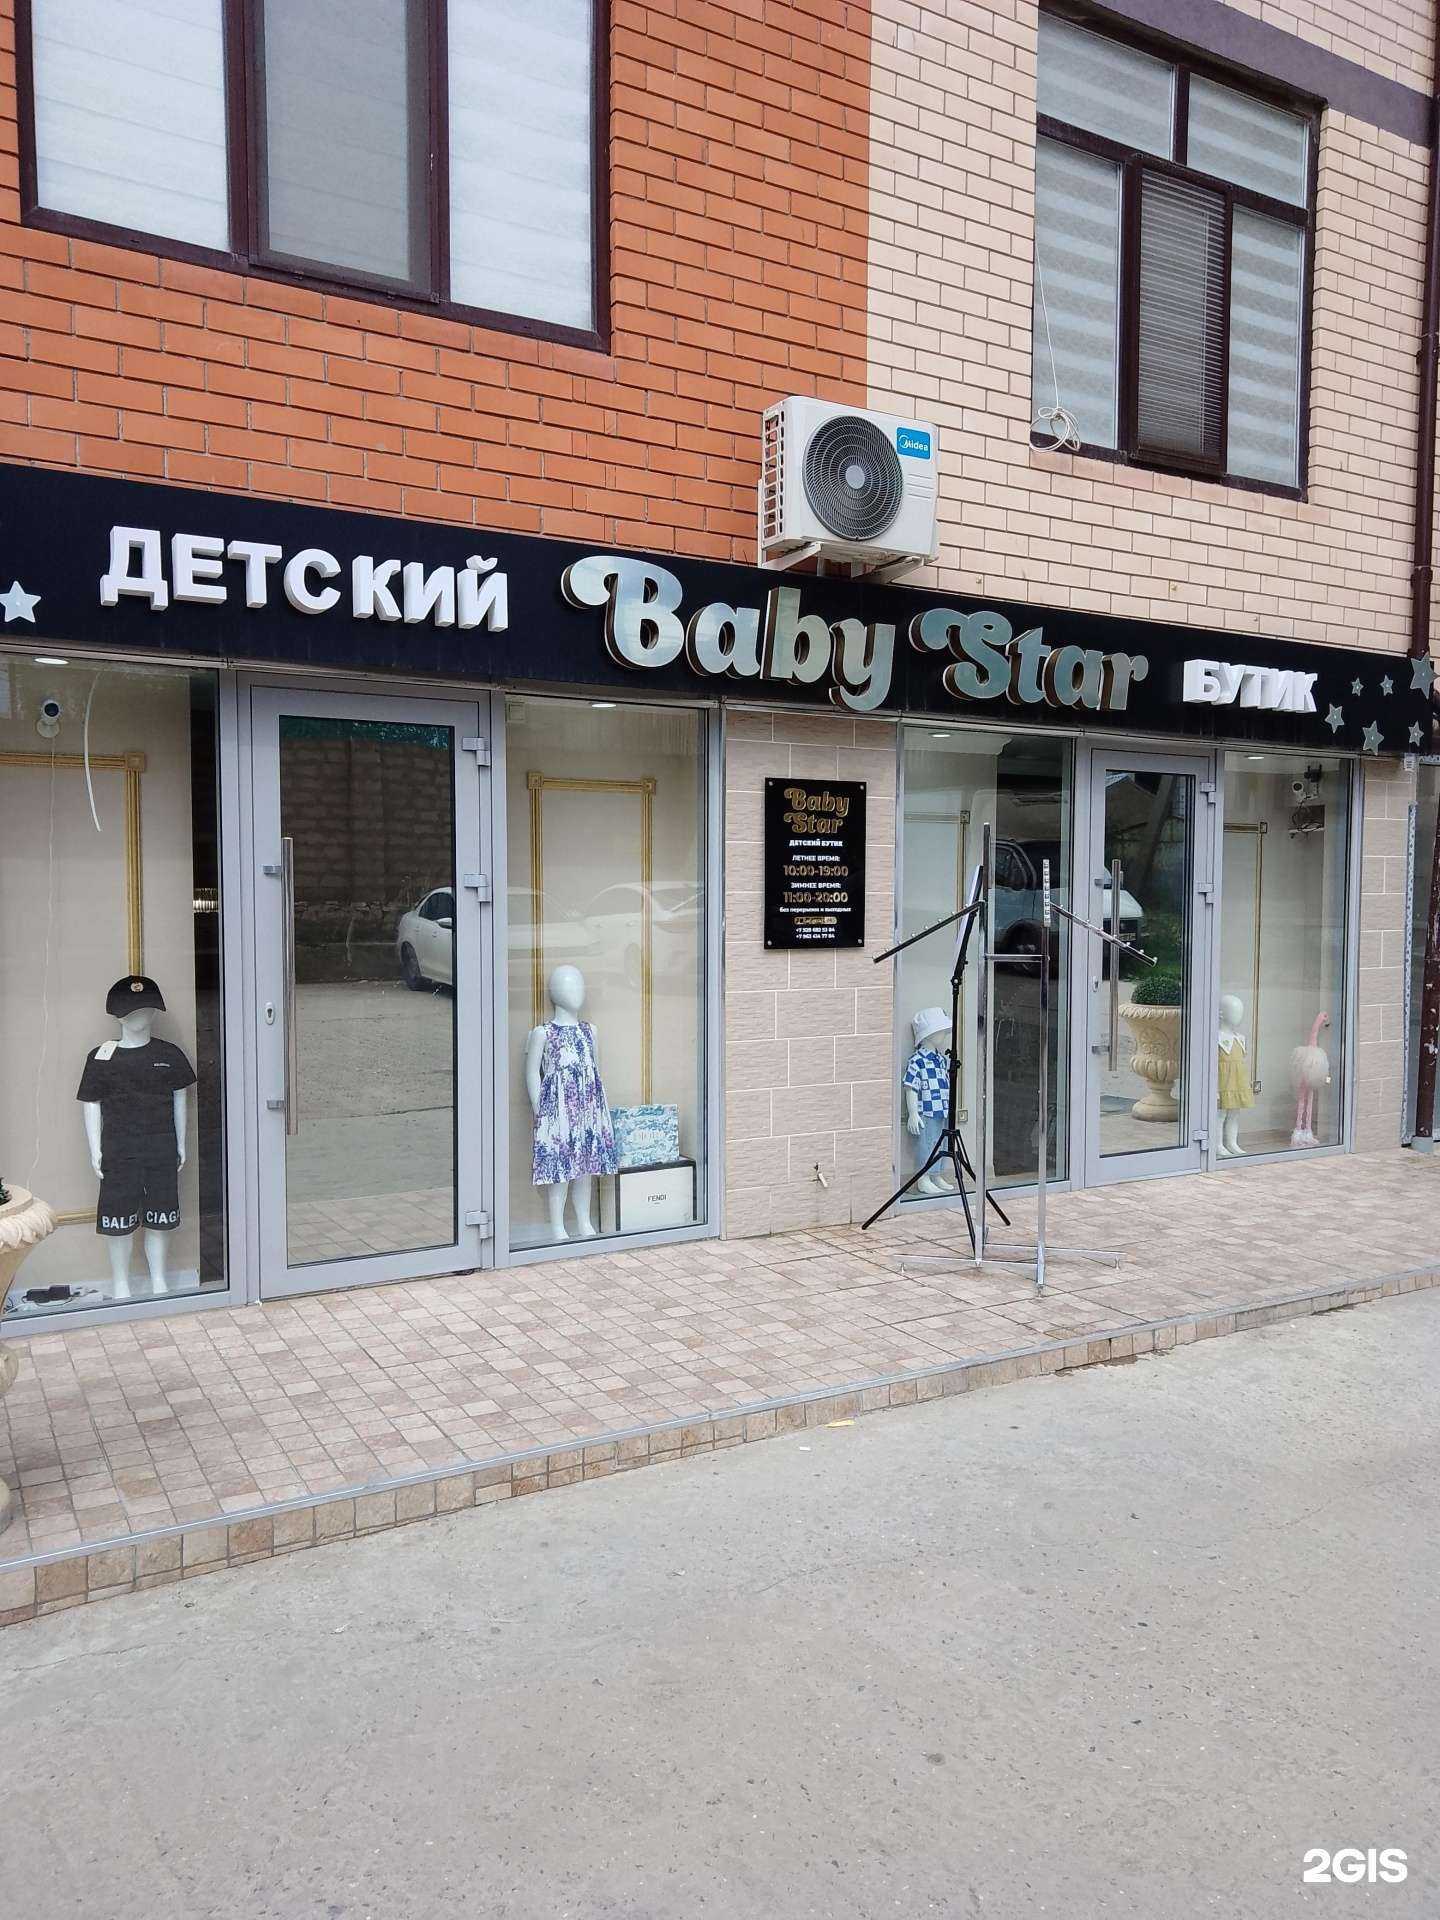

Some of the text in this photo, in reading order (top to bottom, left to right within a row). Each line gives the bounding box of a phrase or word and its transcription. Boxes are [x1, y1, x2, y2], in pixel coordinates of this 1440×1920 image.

[898, 434, 928, 451] Midea
[100, 525, 1318, 713] ДЕТСКИЙ Baby Star БУТИК
[784, 788, 849, 817] Baby
[784, 812, 843, 833] Star
[784, 865, 848, 876] 10:00-19:00
[784, 892, 848, 902] 11:00-20:00
[647, 1194, 667, 1202] FENDI
[146, 1210, 179, 1224] CIAG
